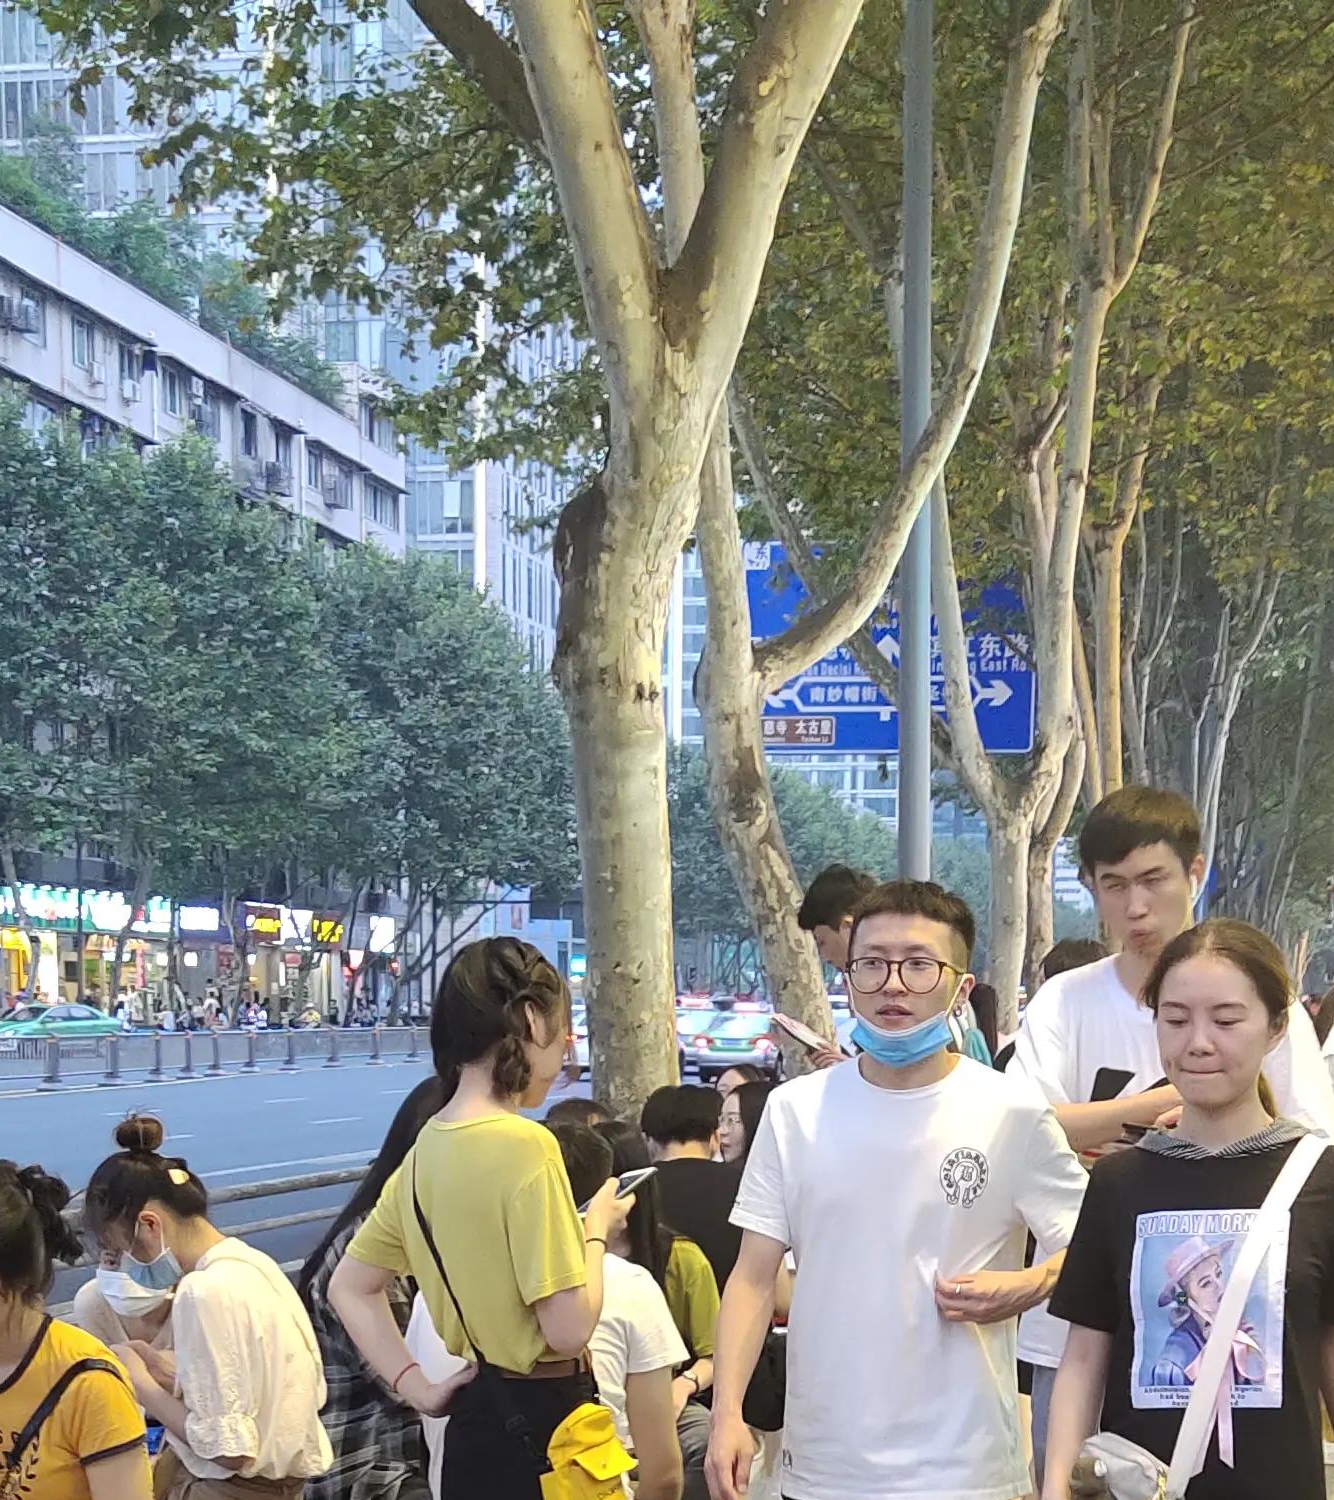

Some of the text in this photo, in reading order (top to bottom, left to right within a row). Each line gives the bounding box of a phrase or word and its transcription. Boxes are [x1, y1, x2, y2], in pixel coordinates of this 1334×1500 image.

[810, 685, 877, 703] 南纱帽街
[1205, 1212, 1259, 1233] MORN
